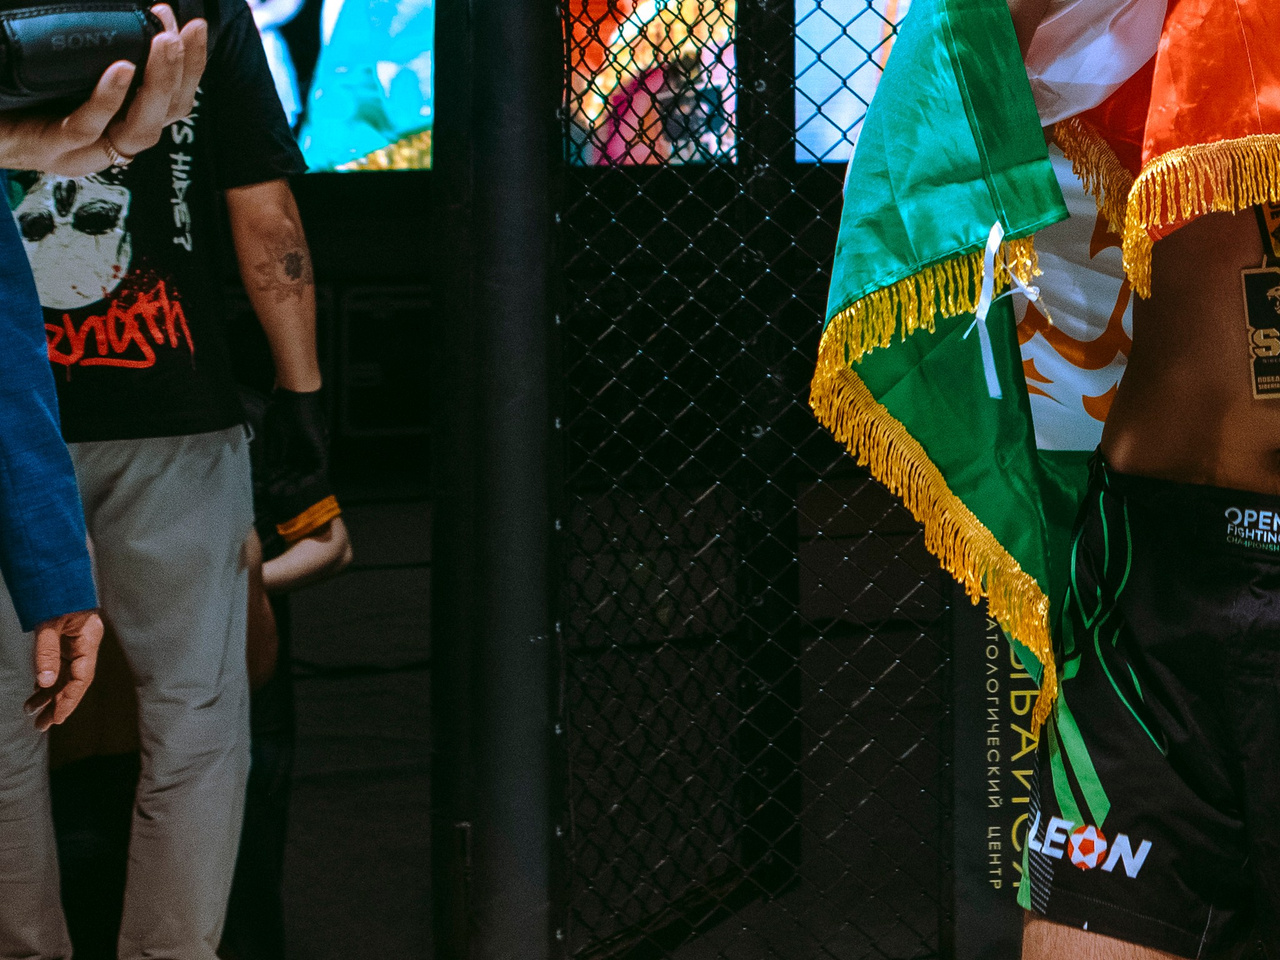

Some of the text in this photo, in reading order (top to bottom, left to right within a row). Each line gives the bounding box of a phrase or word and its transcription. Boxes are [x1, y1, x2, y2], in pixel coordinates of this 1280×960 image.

[51, 29, 118, 51] SONY
[985, 599, 1003, 890] АТОЛОГИЧЕСКИЙ ЦЕНТР
